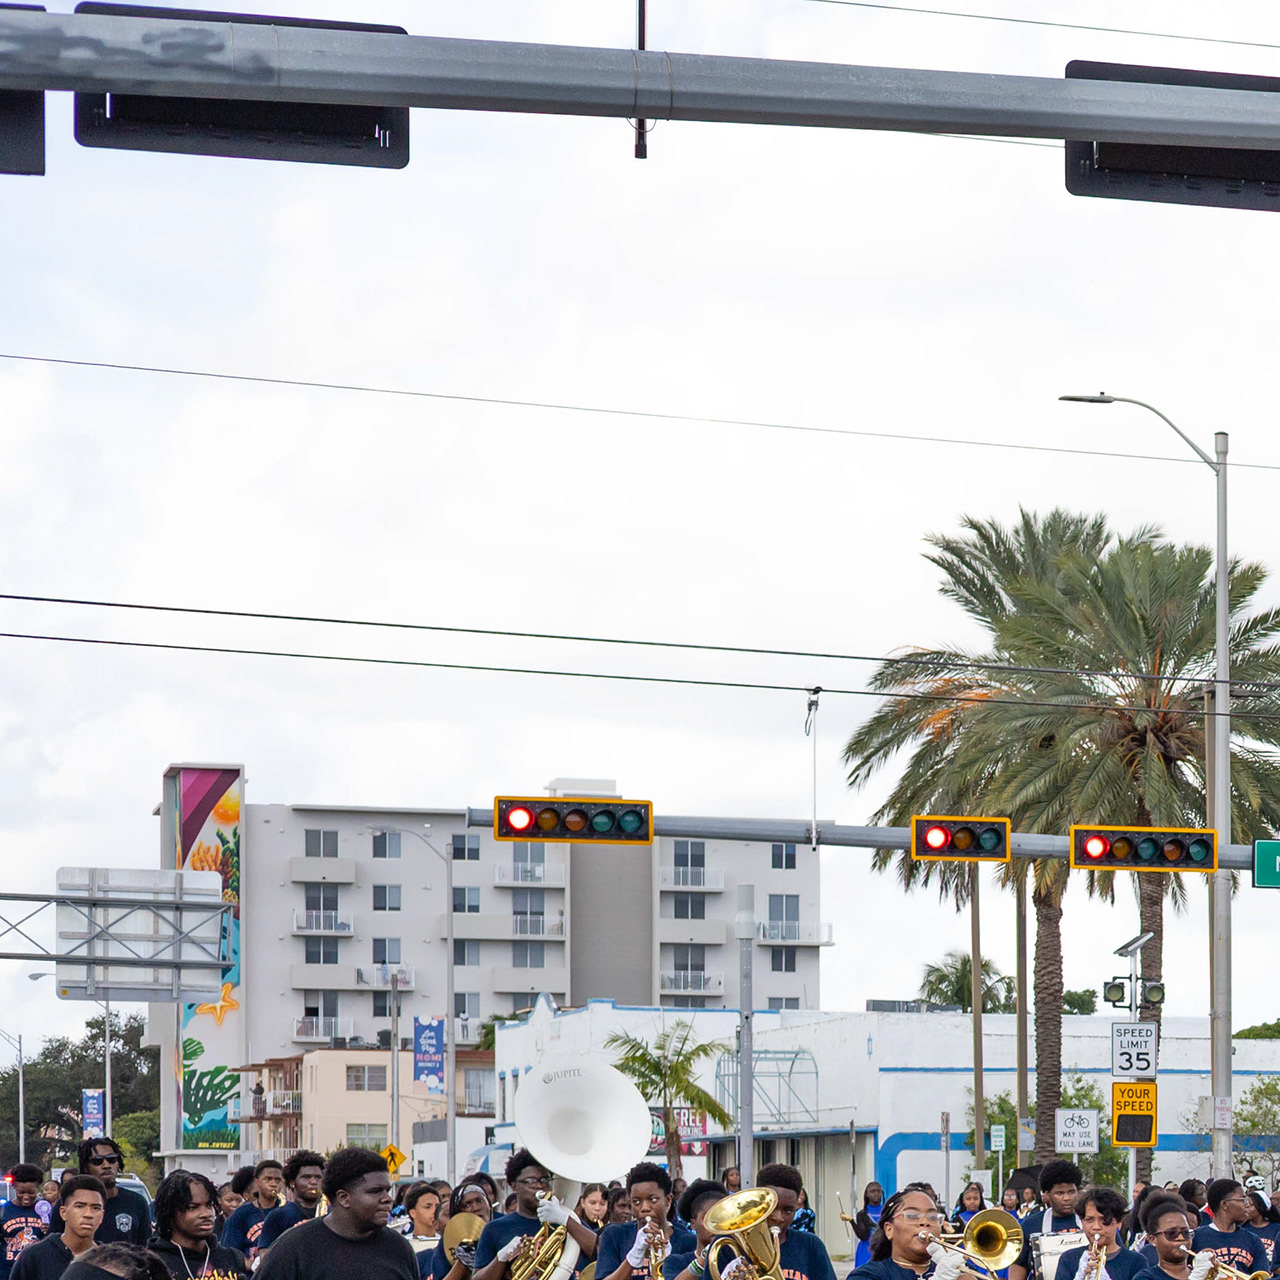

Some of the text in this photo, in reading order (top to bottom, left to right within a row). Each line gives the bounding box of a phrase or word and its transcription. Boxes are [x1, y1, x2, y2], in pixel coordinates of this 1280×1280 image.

[1116, 1028, 1153, 1038] SPEED
[1120, 1040, 1149, 1049] LIMIT
[416, 1053, 442, 1062] NOMI
[1118, 1052, 1151, 1071] 35
[553, 1068, 583, 1080] JUPITE
[1119, 1088, 1150, 1099] YOUR
[1116, 1101, 1153, 1111] SPEED
[674, 1108, 702, 1127] FREE
[677, 1126, 703, 1136] ARKING
[1062, 1131, 1092, 1139] MAY USE
[1059, 1140, 1095, 1148] FULL LANE
